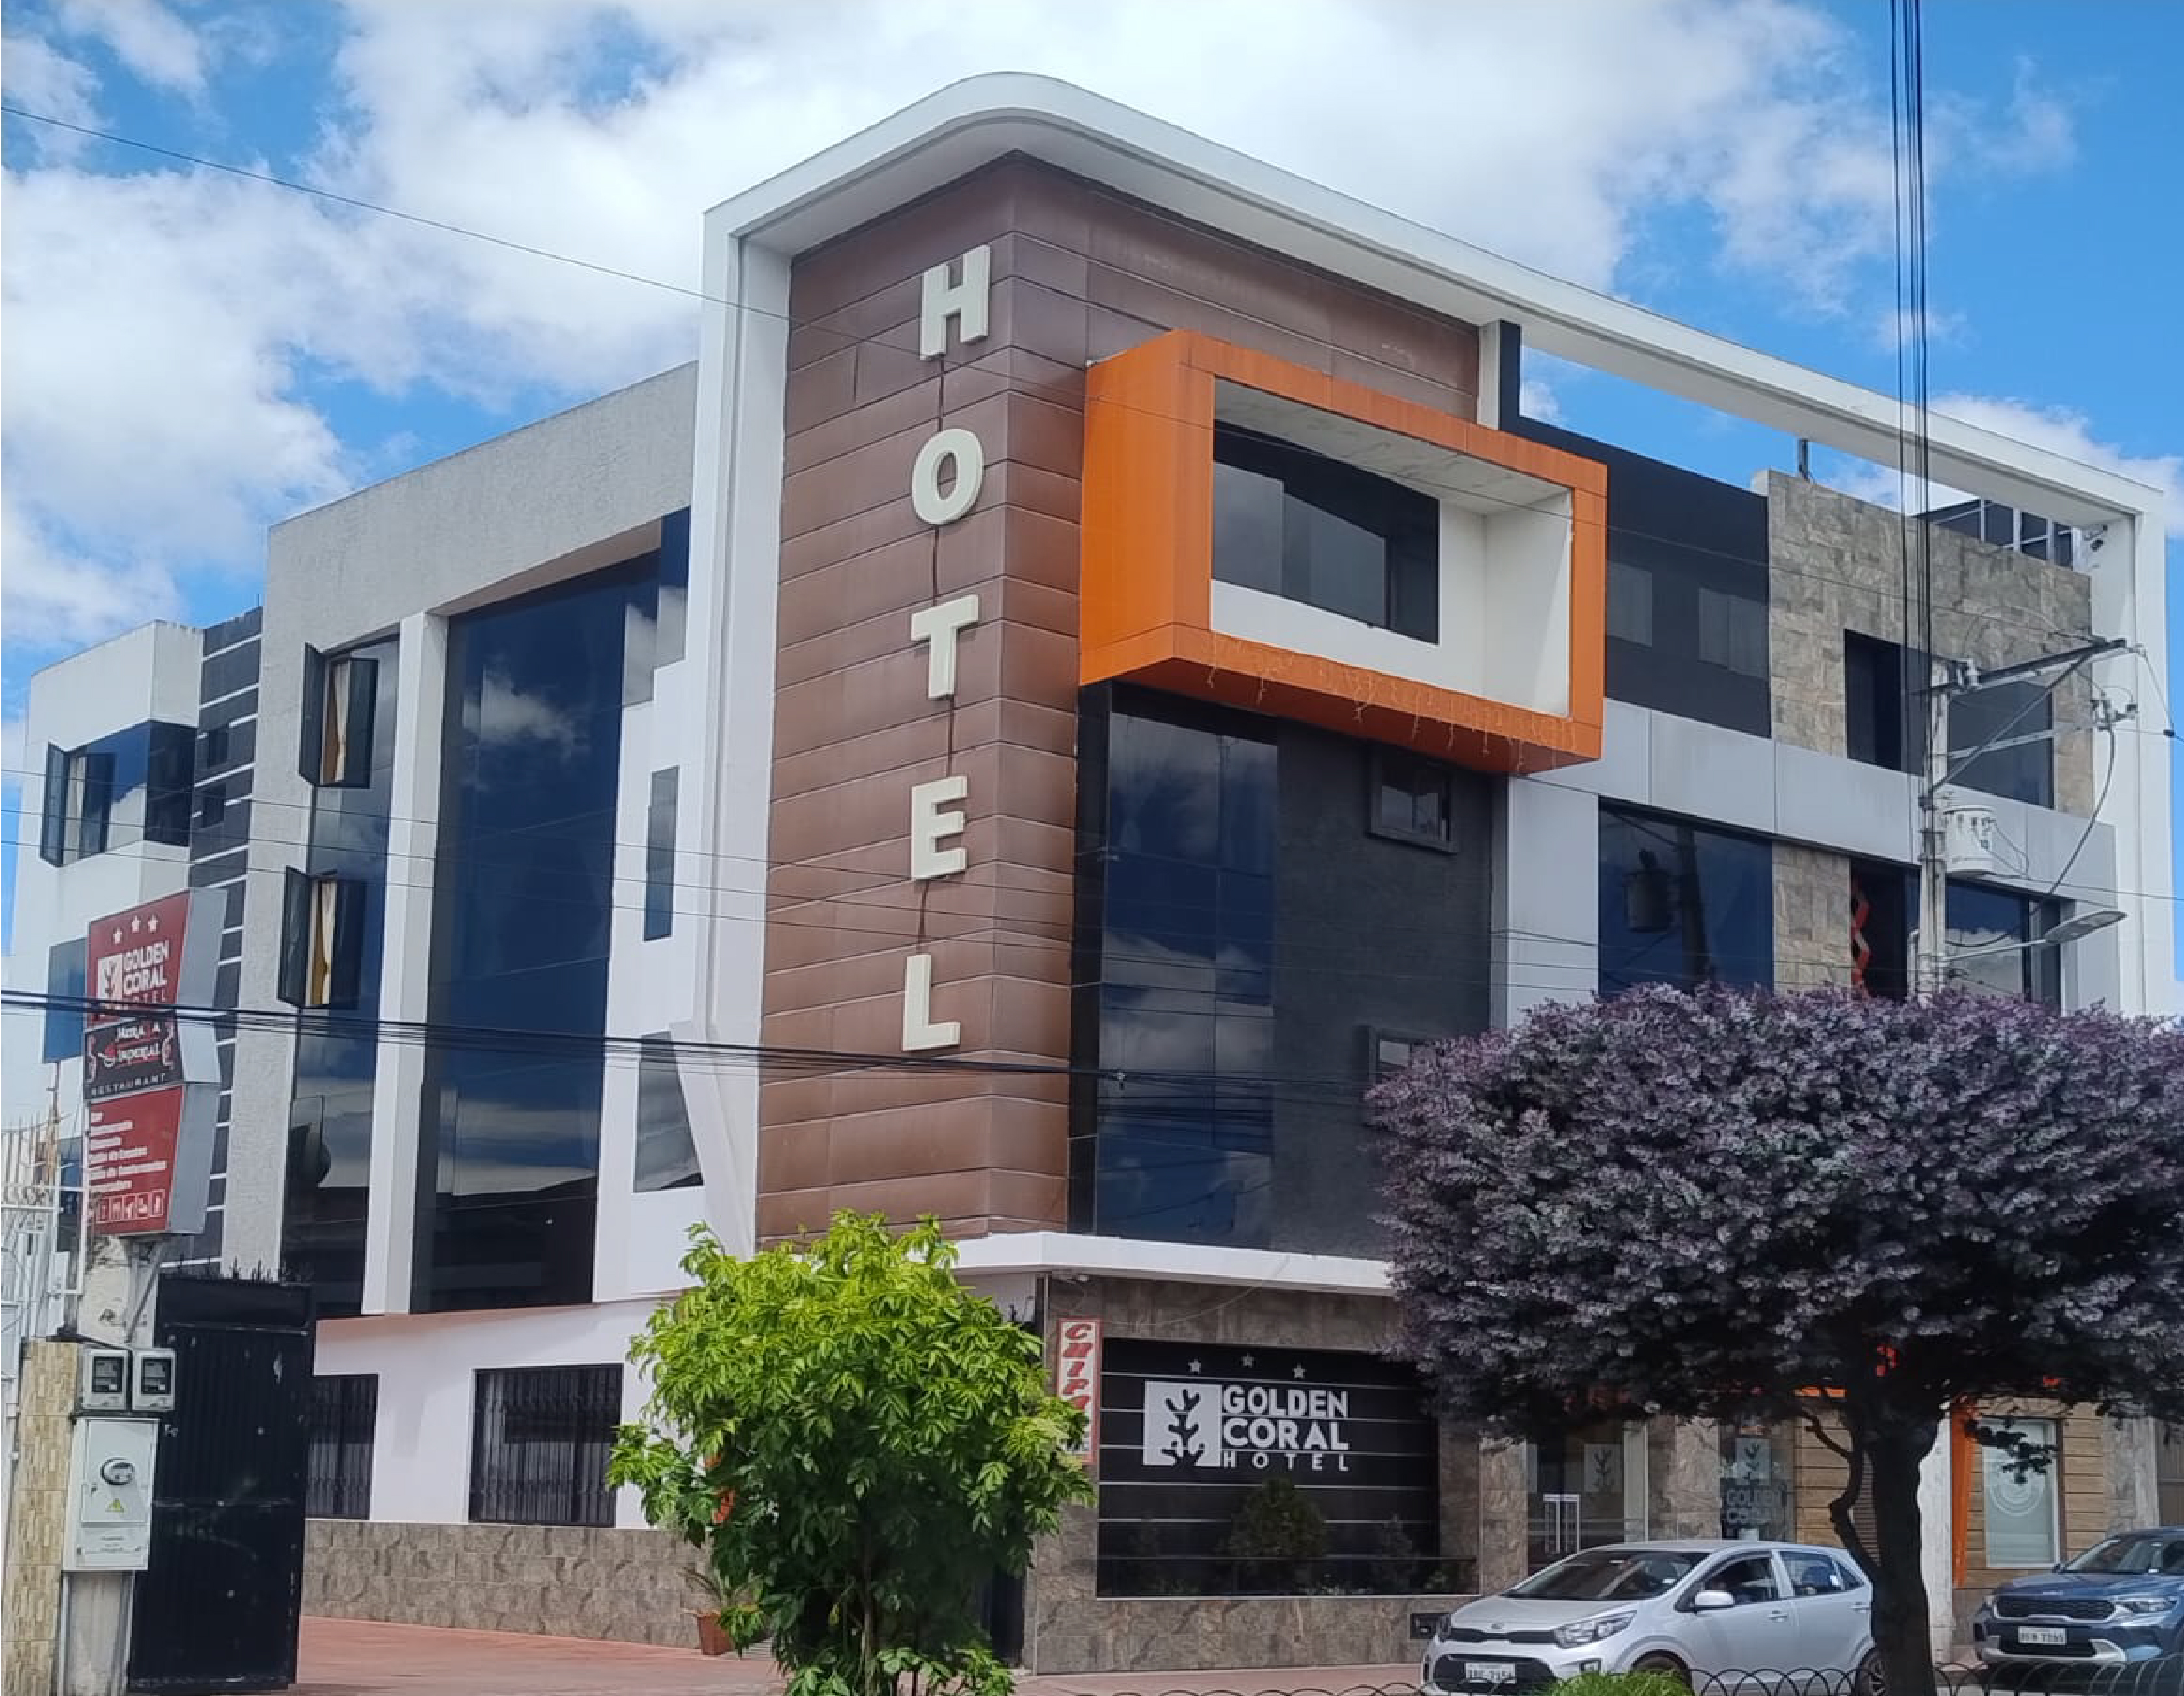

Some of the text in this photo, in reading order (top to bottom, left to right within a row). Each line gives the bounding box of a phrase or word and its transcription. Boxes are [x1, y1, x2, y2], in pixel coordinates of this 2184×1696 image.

[903, 244, 991, 1051] HOTEL
[124, 940, 170, 971] GOLDEN
[124, 965, 168, 995] CORAL
[1223, 1385, 1349, 1418] GOLDEN
[1223, 1417, 1349, 1450] CORAL
[1221, 1452, 1349, 1471] HOTEL
